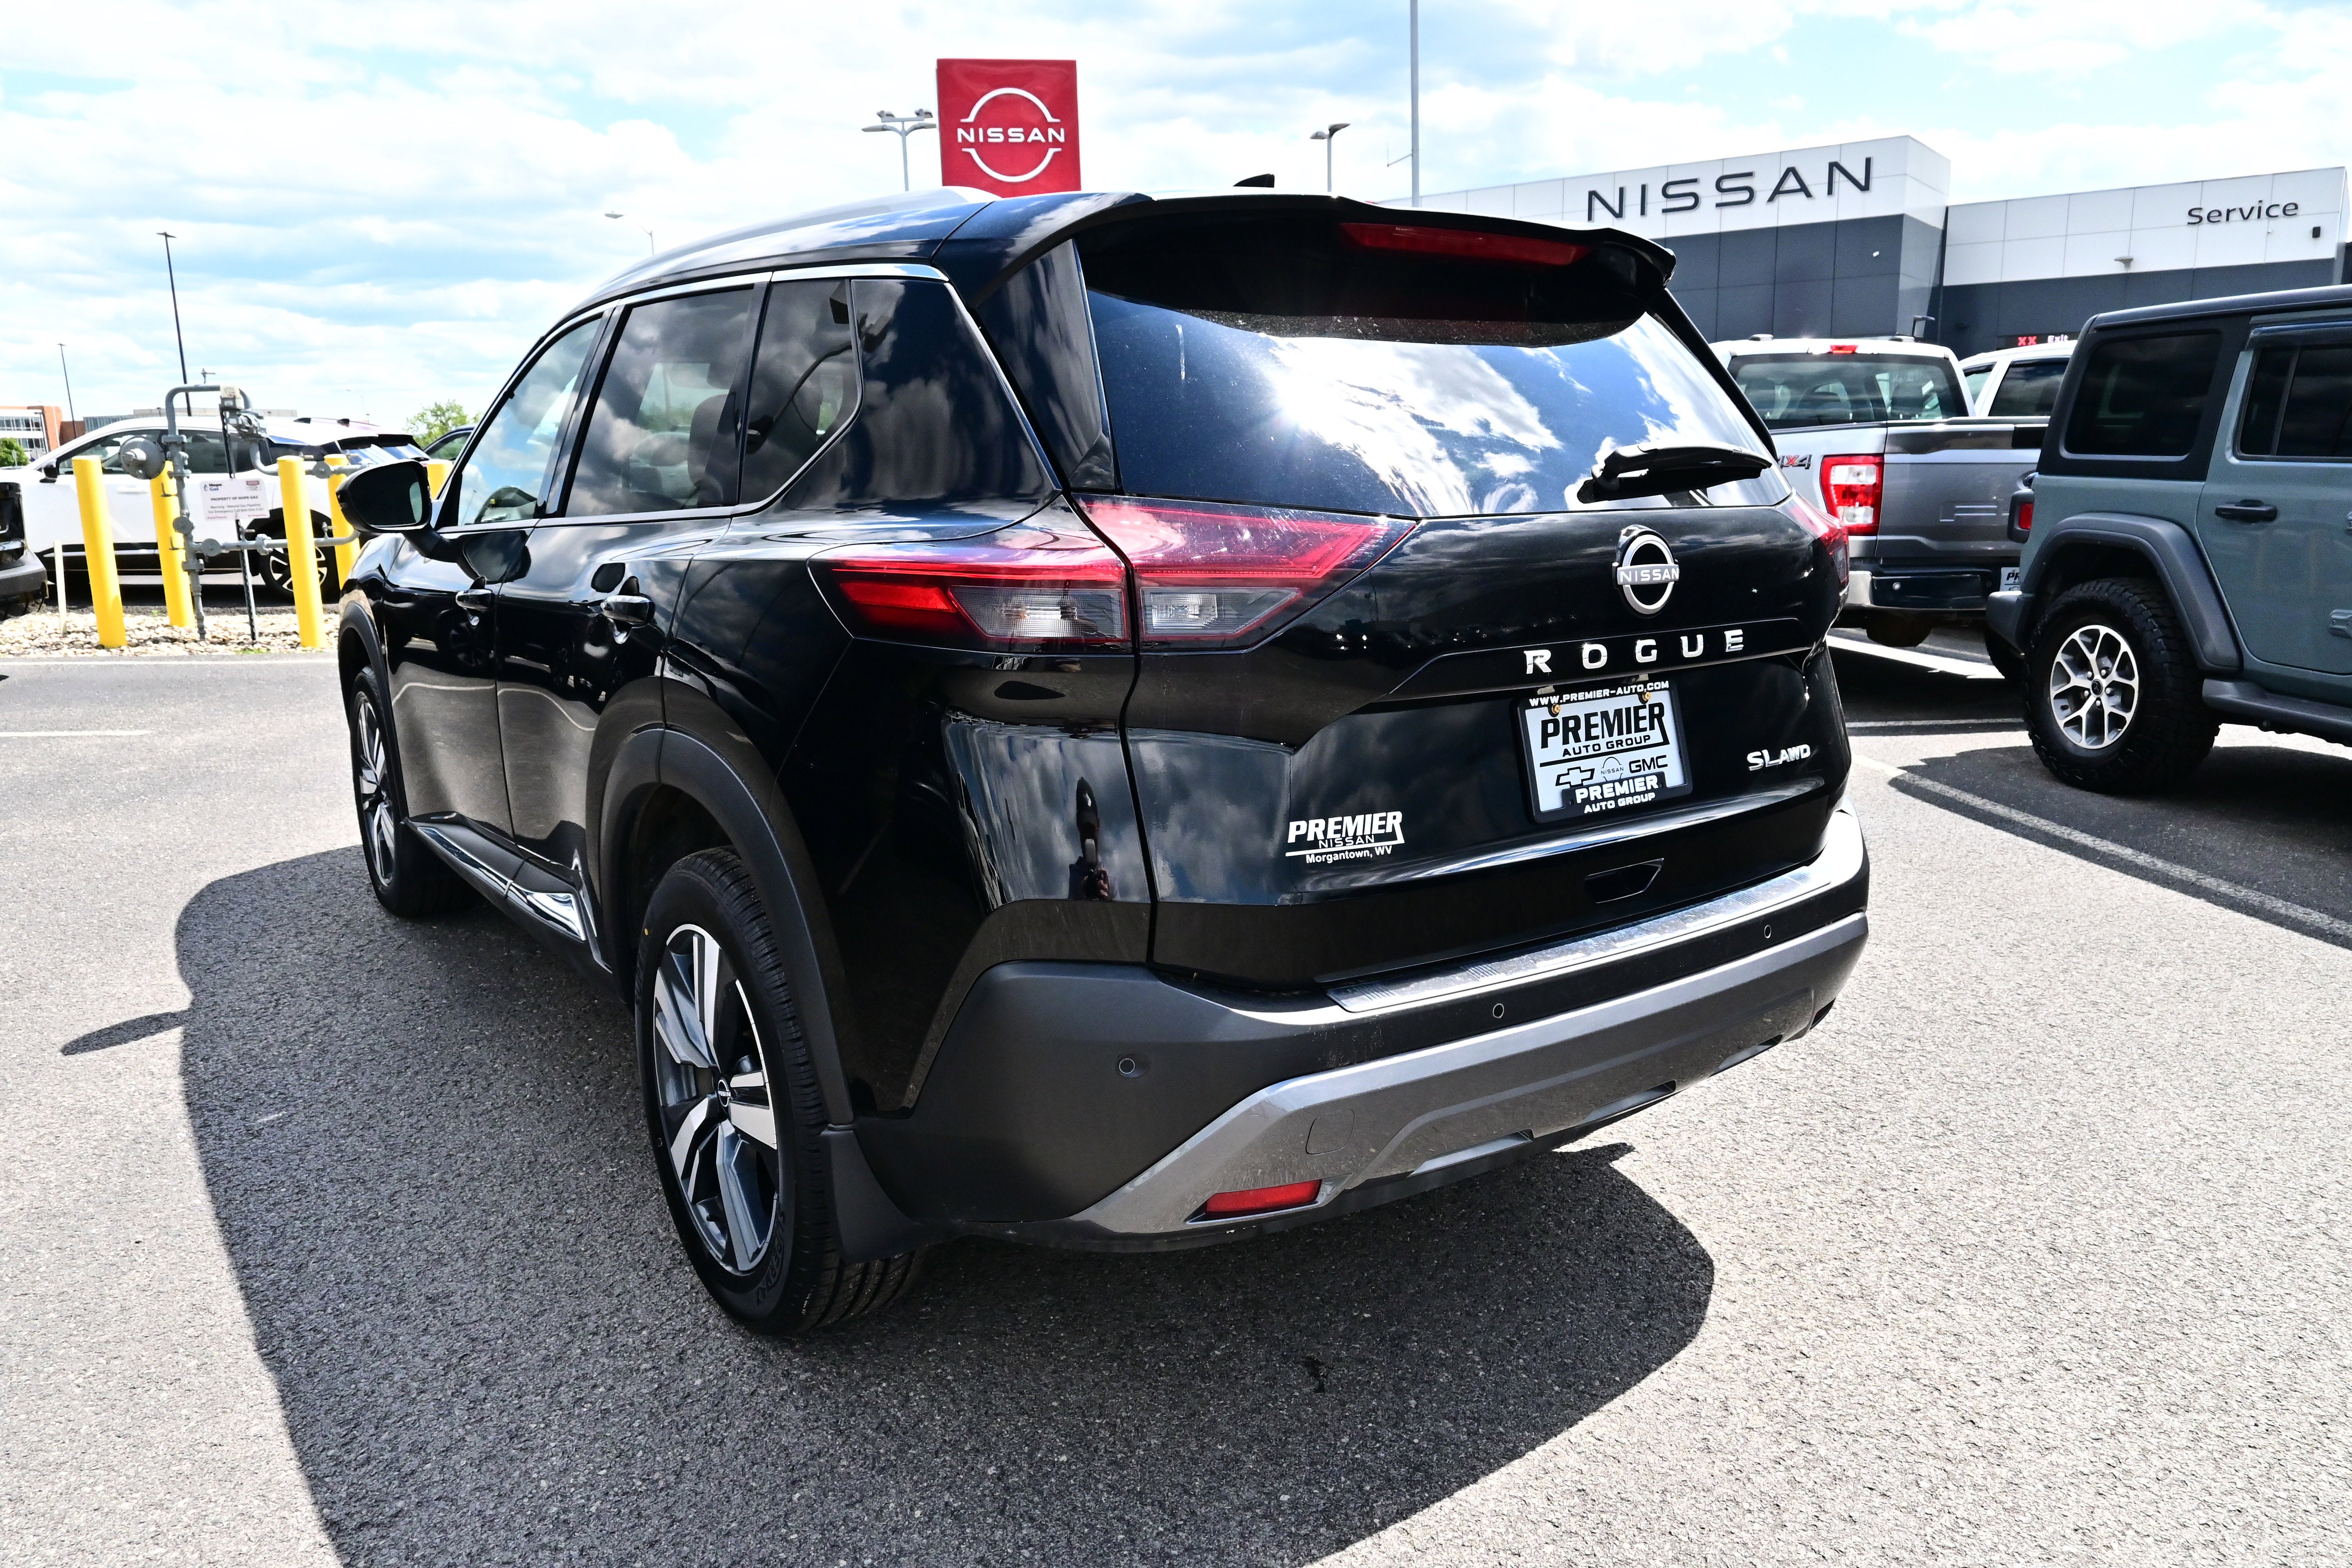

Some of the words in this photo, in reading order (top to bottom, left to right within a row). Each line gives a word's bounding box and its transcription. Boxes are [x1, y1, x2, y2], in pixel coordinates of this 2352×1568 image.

[957, 128, 1065, 143] NISSAN
[1587, 156, 1872, 222] NISSAN
[2187, 200, 2299, 225] Service
[2047, 334, 2069, 343] Exit
[1620, 568, 1680, 583] NISSAN
[1523, 629, 1744, 675] ROGUE
[1529, 681, 1669, 707] WWW.PREMIER-AUTO.COM
[1541, 702, 1669, 749] PREMIER
[1563, 743, 1601, 757] AUTO
[1606, 735, 1651, 749] GROUP
[1601, 766, 1624, 775] NISSAN
[1629, 754, 1668, 773] GMC
[1575, 775, 1659, 804] PREMIER
[1584, 800, 1617, 814] AUTO
[1617, 792, 1656, 807] GROUP
[1288, 811, 1403, 843] PREMIER
[1318, 834, 1375, 849] NISSAN
[1306, 850, 1373, 864] Morgantown,
[1375, 845, 1393, 856] WV
